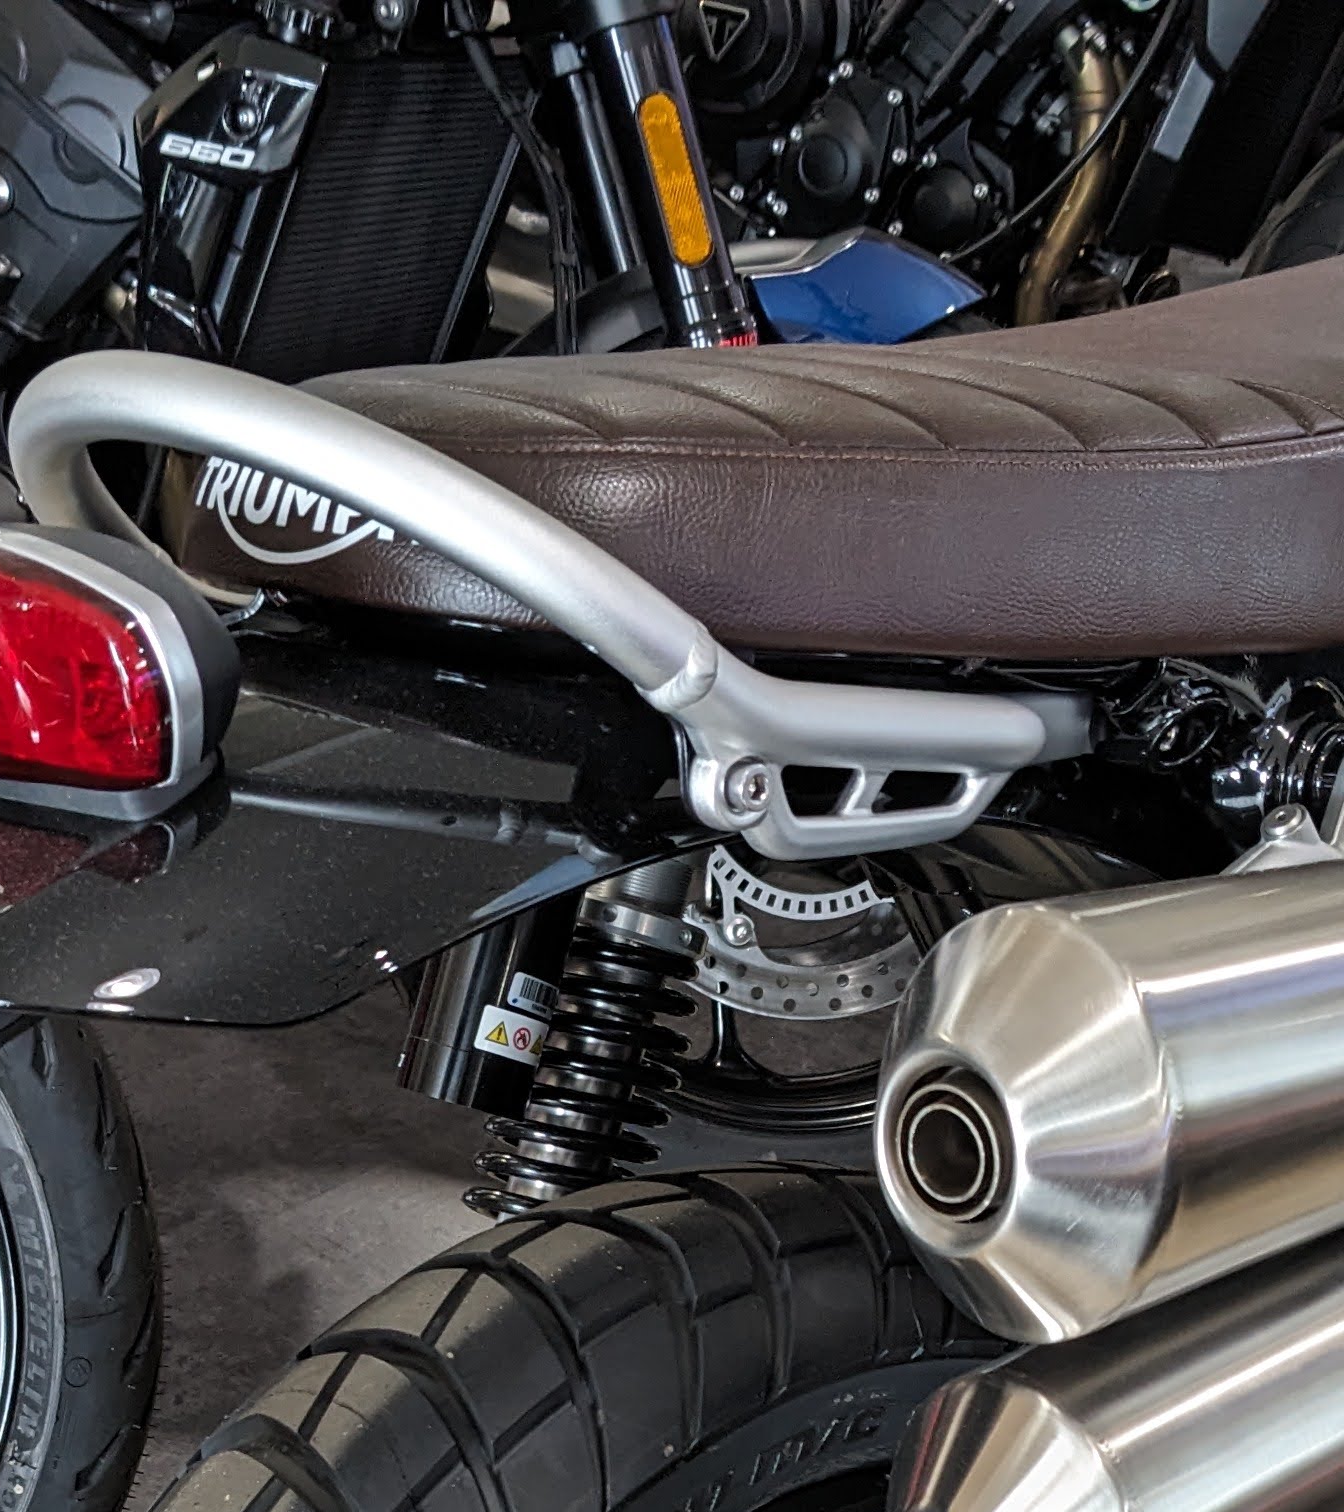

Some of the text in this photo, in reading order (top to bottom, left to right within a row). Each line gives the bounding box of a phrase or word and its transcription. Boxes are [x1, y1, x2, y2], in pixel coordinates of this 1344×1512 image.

[158, 130, 257, 171] 660
[192, 454, 420, 566] TRIUMP
[16, 1213, 52, 1438] MICHELIN
